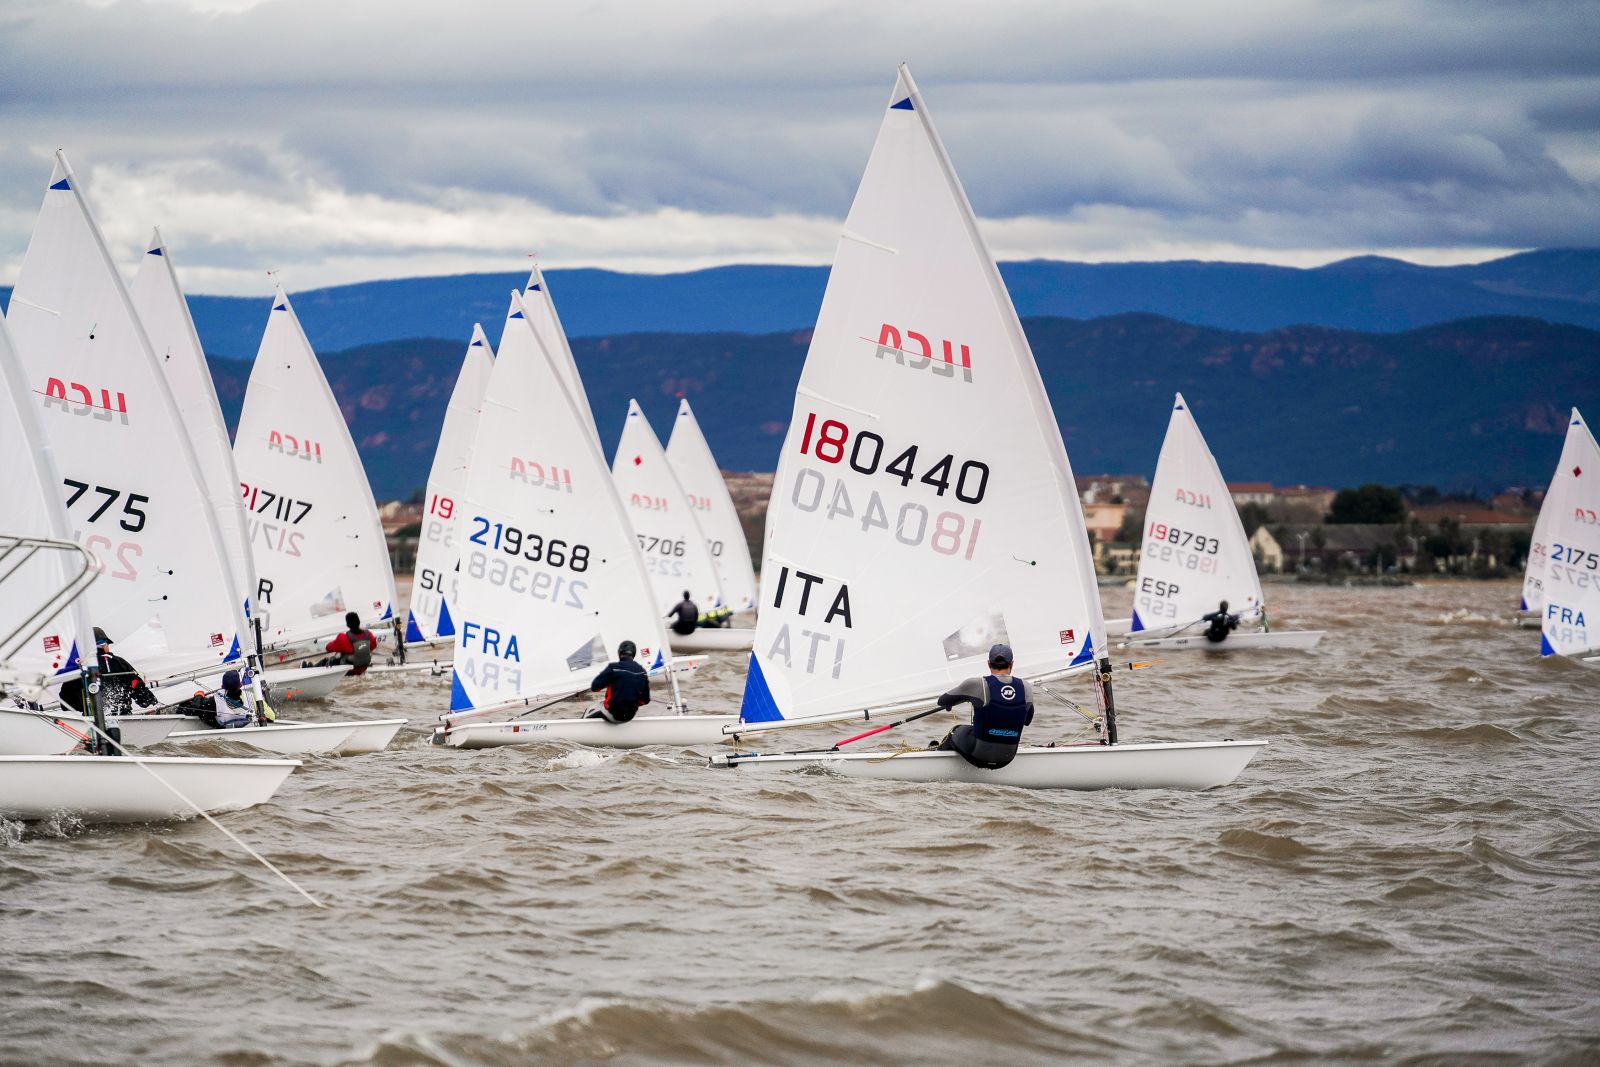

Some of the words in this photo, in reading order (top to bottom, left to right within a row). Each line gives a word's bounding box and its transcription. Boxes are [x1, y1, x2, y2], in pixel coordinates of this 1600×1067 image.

[800, 413, 990, 505] 180440
[64, 478, 149, 533] 775
[431, 494, 457, 520] 19
[469, 516, 591, 573] 219368
[1148, 522, 1220, 555] 198793
[1551, 544, 1599, 570] 2175
[773, 567, 852, 629] ITA
[1141, 577, 1180, 599] ESP
[1548, 604, 1586, 627] FRA
[462, 621, 521, 663] FRA
